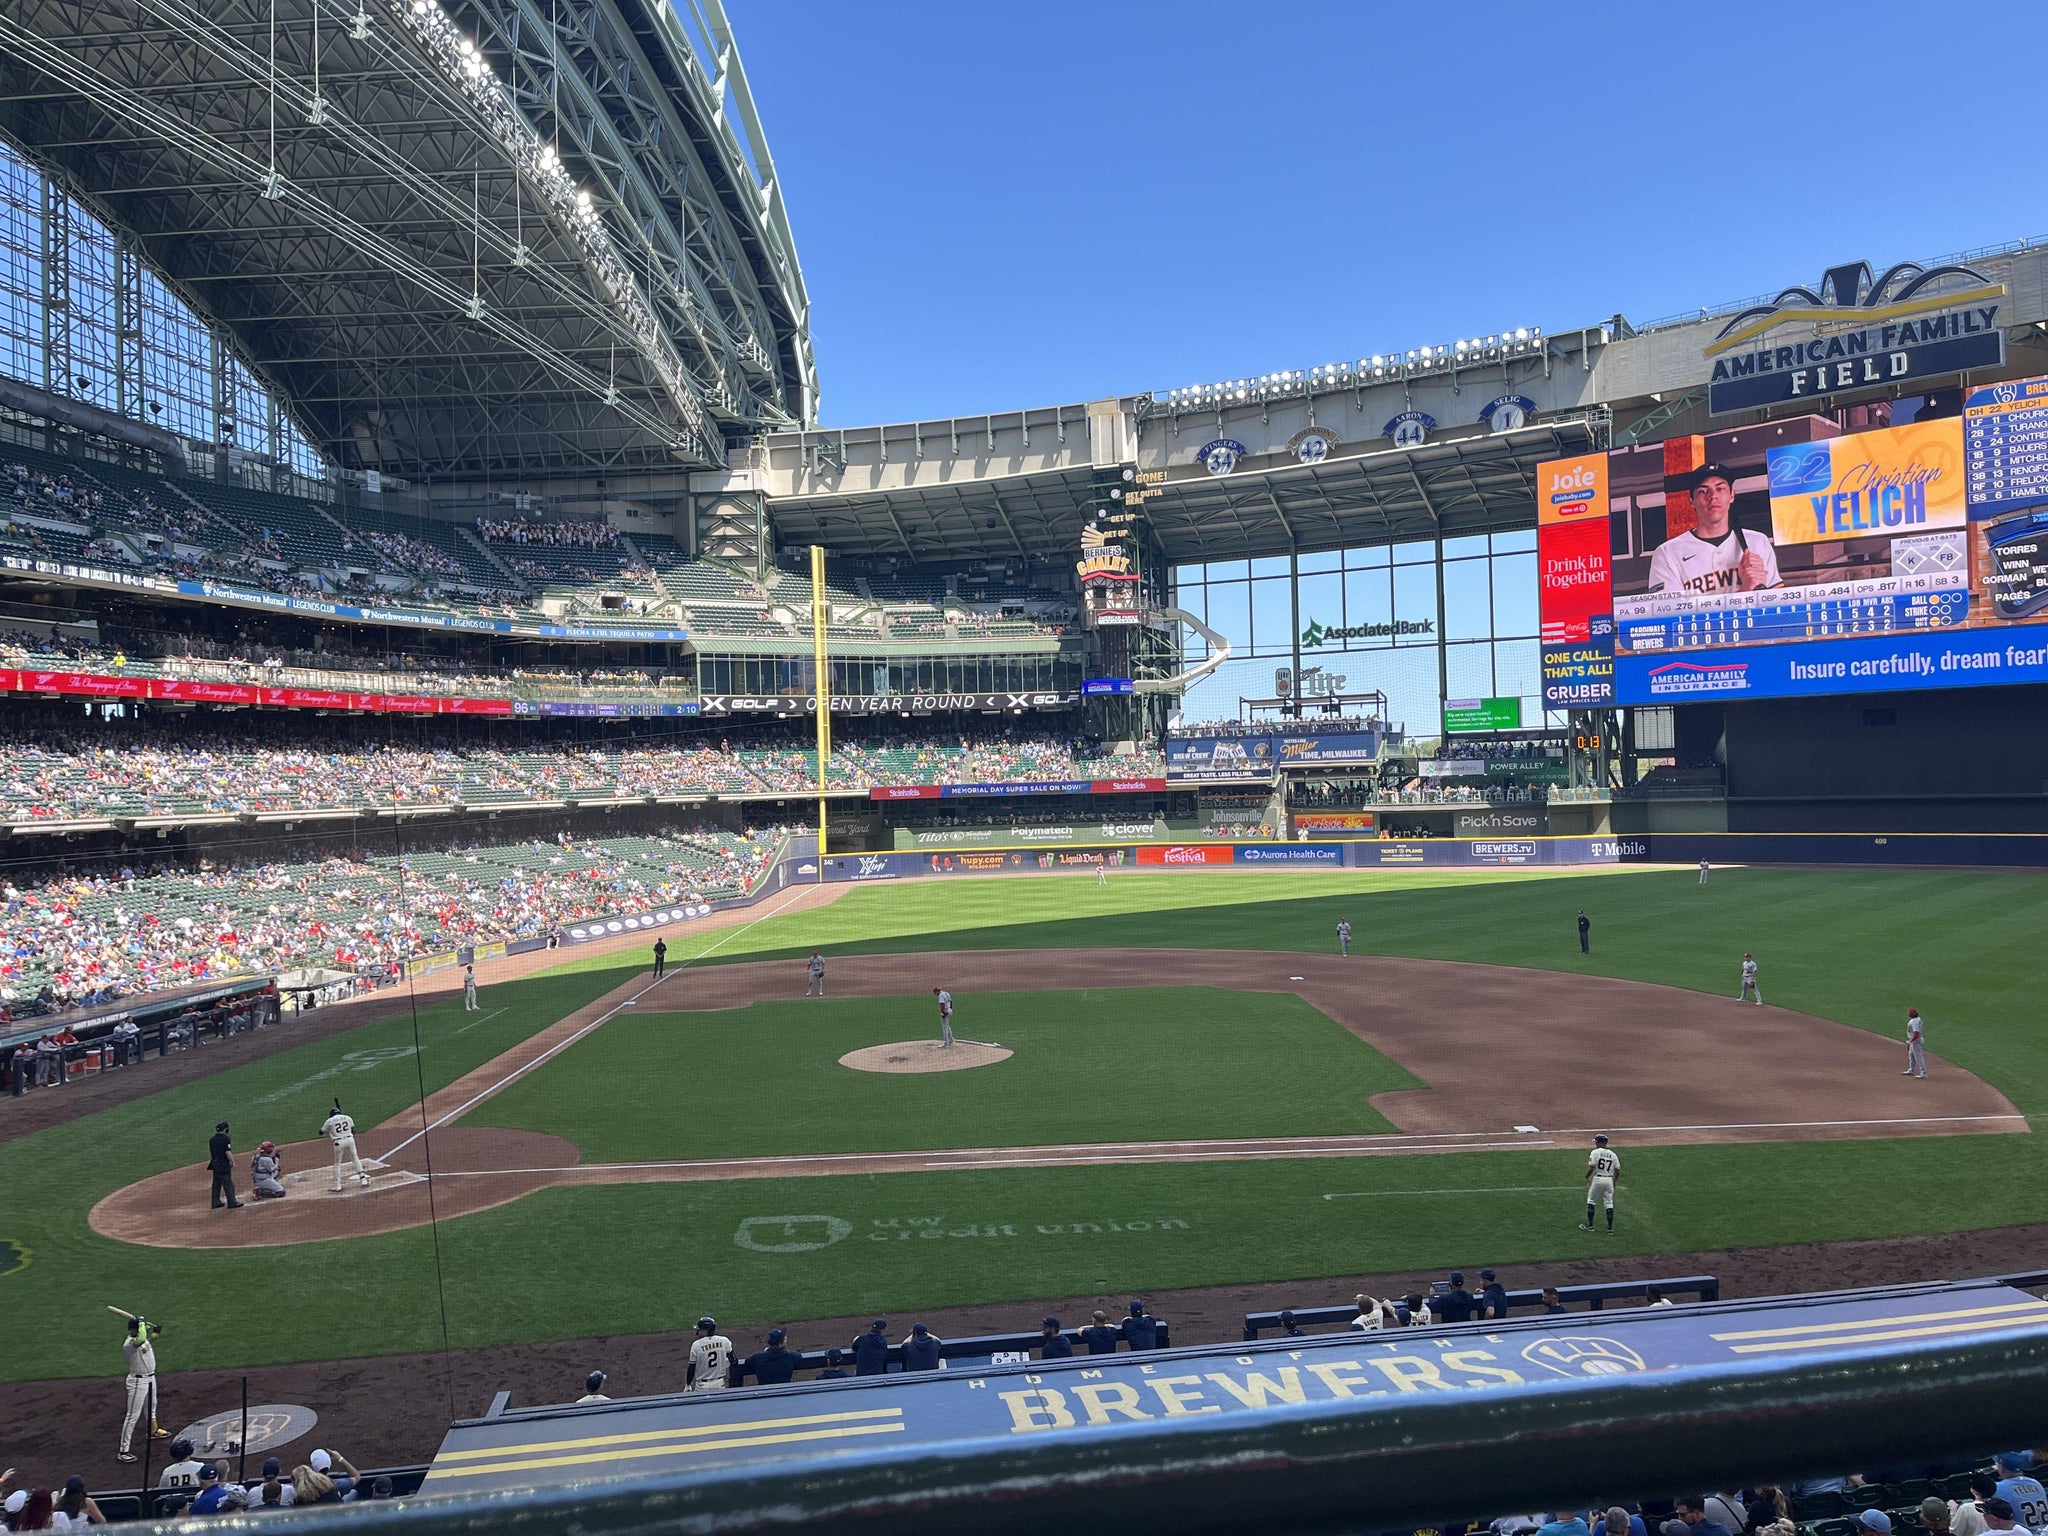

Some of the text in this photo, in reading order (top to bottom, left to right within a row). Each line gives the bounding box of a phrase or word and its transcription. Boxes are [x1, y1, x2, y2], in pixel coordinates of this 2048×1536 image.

[1711, 305, 1999, 381] AMERICAN FAMILY
[1791, 352, 1908, 394] FIELD
[1494, 395, 1520, 407] SELIG
[1970, 399, 2041, 416] DH 22 YELICH
[1395, 412, 1423, 423] AARON
[1503, 411, 1512, 430] 1
[1397, 427, 1421, 443] 44
[1971, 429, 1984, 438] 2B
[1993, 427, 2000, 435] 2
[1204, 440, 1238, 452] FINGERS
[1302, 443, 1325, 458] 42
[1972, 442, 2047, 459] 1B 9 BAUERS
[1209, 453, 1232, 470] 34
[1769, 450, 1832, 488] 22
[1135, 471, 1168, 484] GONE!
[1551, 466, 1597, 492] Joie
[1837, 461, 1944, 501] Christian
[1972, 482, 1986, 491] RF
[1992, 480, 2004, 488] 10
[1140, 489, 1163, 498] OUTTA
[1553, 490, 1592, 503] joiebaby.com
[1810, 480, 1926, 534] YELICH
[1110, 514, 1125, 523] GET
[1103, 529, 1128, 539] GET UP
[1900, 537, 1929, 545] PREVIOUS
[1084, 545, 1122, 559] BERNIE'S
[1995, 544, 2038, 556] TORRES
[1940, 553, 1953, 561] F8
[1076, 555, 1130, 576] CHALET
[1547, 555, 1603, 574] Drink in
[2002, 559, 2030, 570] WINN
[1544, 569, 1608, 590] Together
[1982, 573, 2027, 584] GORMAN
[212, 588, 336, 614] Northwestern Mutual LEGENDS CLUB
[1630, 591, 1681, 602] SEASON STATS
[1634, 606, 1646, 615] 99
[1656, 605, 1671, 613] AVG
[1675, 602, 1693, 611] .275
[1761, 594, 1777, 603] OBP
[1780, 591, 1802, 600] .333
[1828, 586, 1850, 596] .484
[1857, 585, 1874, 593] OPS
[1877, 582, 1897, 591] .817
[1914, 579, 1926, 587] 16
[1935, 577, 1948, 586] SB
[1911, 595, 1928, 605] BALL
[1995, 590, 2031, 602] PAGÉS
[1904, 606, 1928, 617] STRIKE
[371, 609, 495, 630] Northwestern Mutual LEGENDS CLUB
[1915, 617, 1928, 627] OUT
[1591, 623, 1612, 635] 250
[1630, 624, 1666, 638] CARDINALS
[1633, 637, 1664, 650] BREWERS
[1544, 650, 1612, 664] ONE CALL...
[1544, 664, 1613, 679] THAT'S ALL!
[1790, 660, 1846, 680] Insure
[1850, 652, 1935, 678] carefully,
[1940, 650, 2001, 670] dream
[1651, 669, 1746, 685] AMERICAN FAMILY
[1309, 671, 1347, 697] Lite
[1657, 681, 1740, 692] INSURANCE
[1546, 683, 1612, 700] GRUBER
[702, 696, 726, 711] X
[731, 698, 778, 709] GOLF
[859, 696, 903, 711] YEAR
[912, 695, 975, 709] ROUND
[1007, 693, 1079, 707] X GOLF
[513, 702, 529, 714] 96
[1576, 734, 1600, 749] 0:13
[1173, 752, 1191, 760] BREW
[1280, 740, 1319, 759] Miller
[1300, 749, 1367, 760] TIME, MILWAUKEE
[1519, 762, 1544, 770] ALLEY
[1112, 782, 1147, 791] Steinhafels
[889, 789, 920, 798] Steinhafels
[1211, 809, 1262, 823] Johnsonville
[1502, 815, 1538, 827] Save
[1115, 823, 1154, 835] clover
[1302, 817, 1343, 830] Surfside
[917, 832, 949, 843] Tito's
[1011, 826, 1073, 837] Polymatech
[1874, 837, 1887, 845] 400
[1261, 849, 1336, 859] Aurora Health Care
[1475, 844, 1532, 854] BREWERS.TV
[1591, 842, 1646, 857] T Mobile
[961, 856, 1004, 866] hupy.com
[1059, 852, 1104, 865] Liquid Death
[1164, 850, 1206, 863] festival
[335, 1121, 349, 1134] 22
[1598, 1158, 1613, 1172] 67
[867, 1218, 1192, 1241] credit union
[708, 1350, 718, 1368] 2
[968, 1334, 1505, 1389] HOME OF THE
[998, 1350, 1525, 1433] BREWERS
[2020, 1500, 2048, 1527] 22
